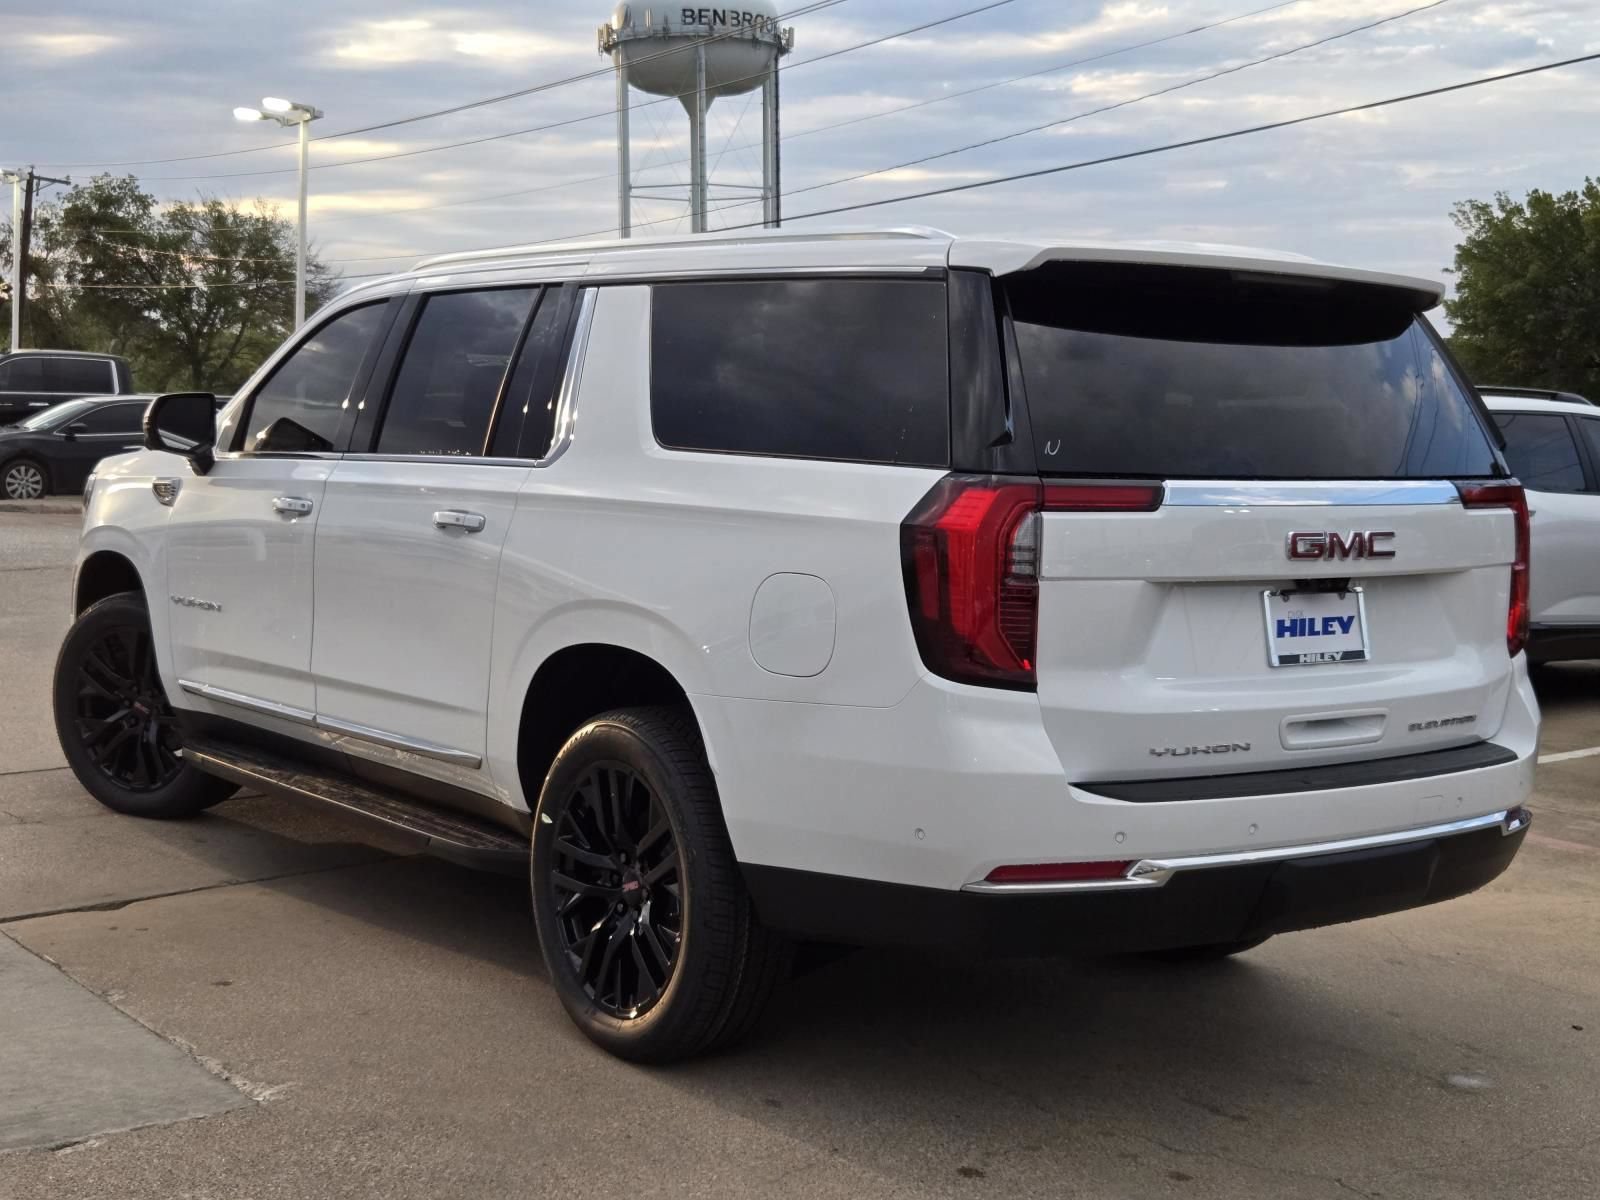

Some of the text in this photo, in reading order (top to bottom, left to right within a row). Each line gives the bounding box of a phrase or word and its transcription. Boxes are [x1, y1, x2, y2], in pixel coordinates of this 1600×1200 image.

[1286, 530, 1396, 560] GMC
[1276, 615, 1355, 638] HILEY
[1299, 651, 1344, 664] HILEY
[1149, 743, 1251, 757] YUKON
